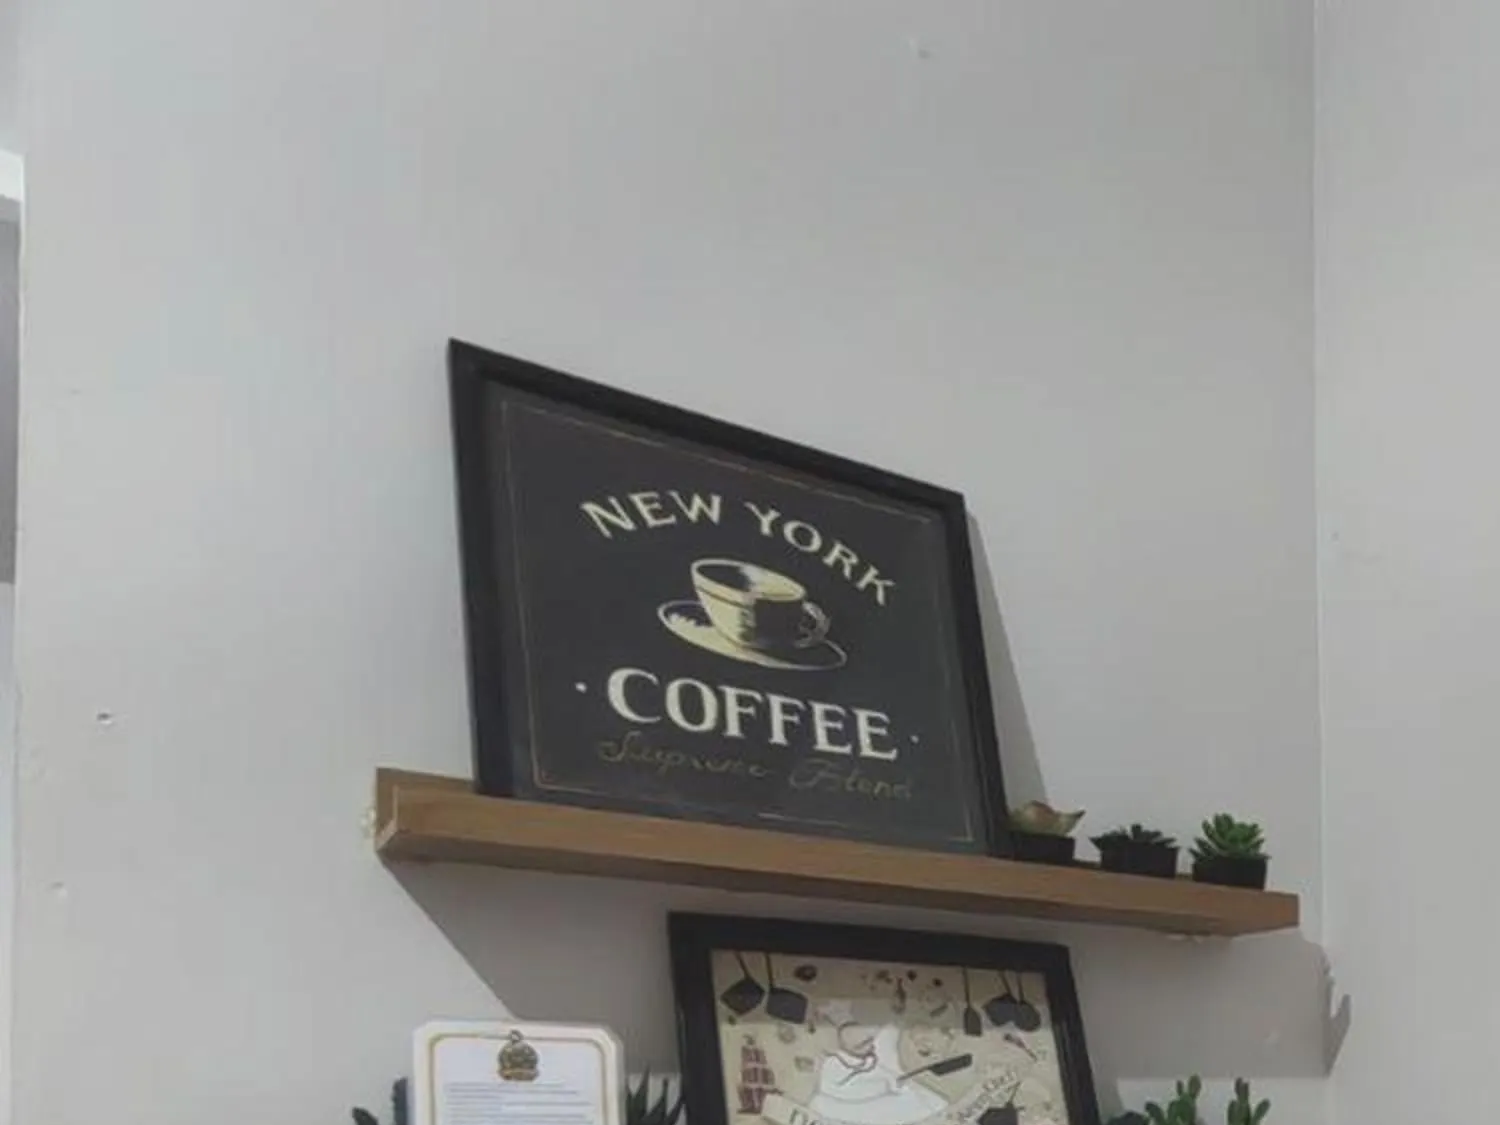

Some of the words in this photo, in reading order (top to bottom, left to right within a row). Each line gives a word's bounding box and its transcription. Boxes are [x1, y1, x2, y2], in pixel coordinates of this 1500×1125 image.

[580, 490, 723, 538] NEW
[744, 501, 895, 606] YORK
[606, 667, 899, 760] COFFEE
